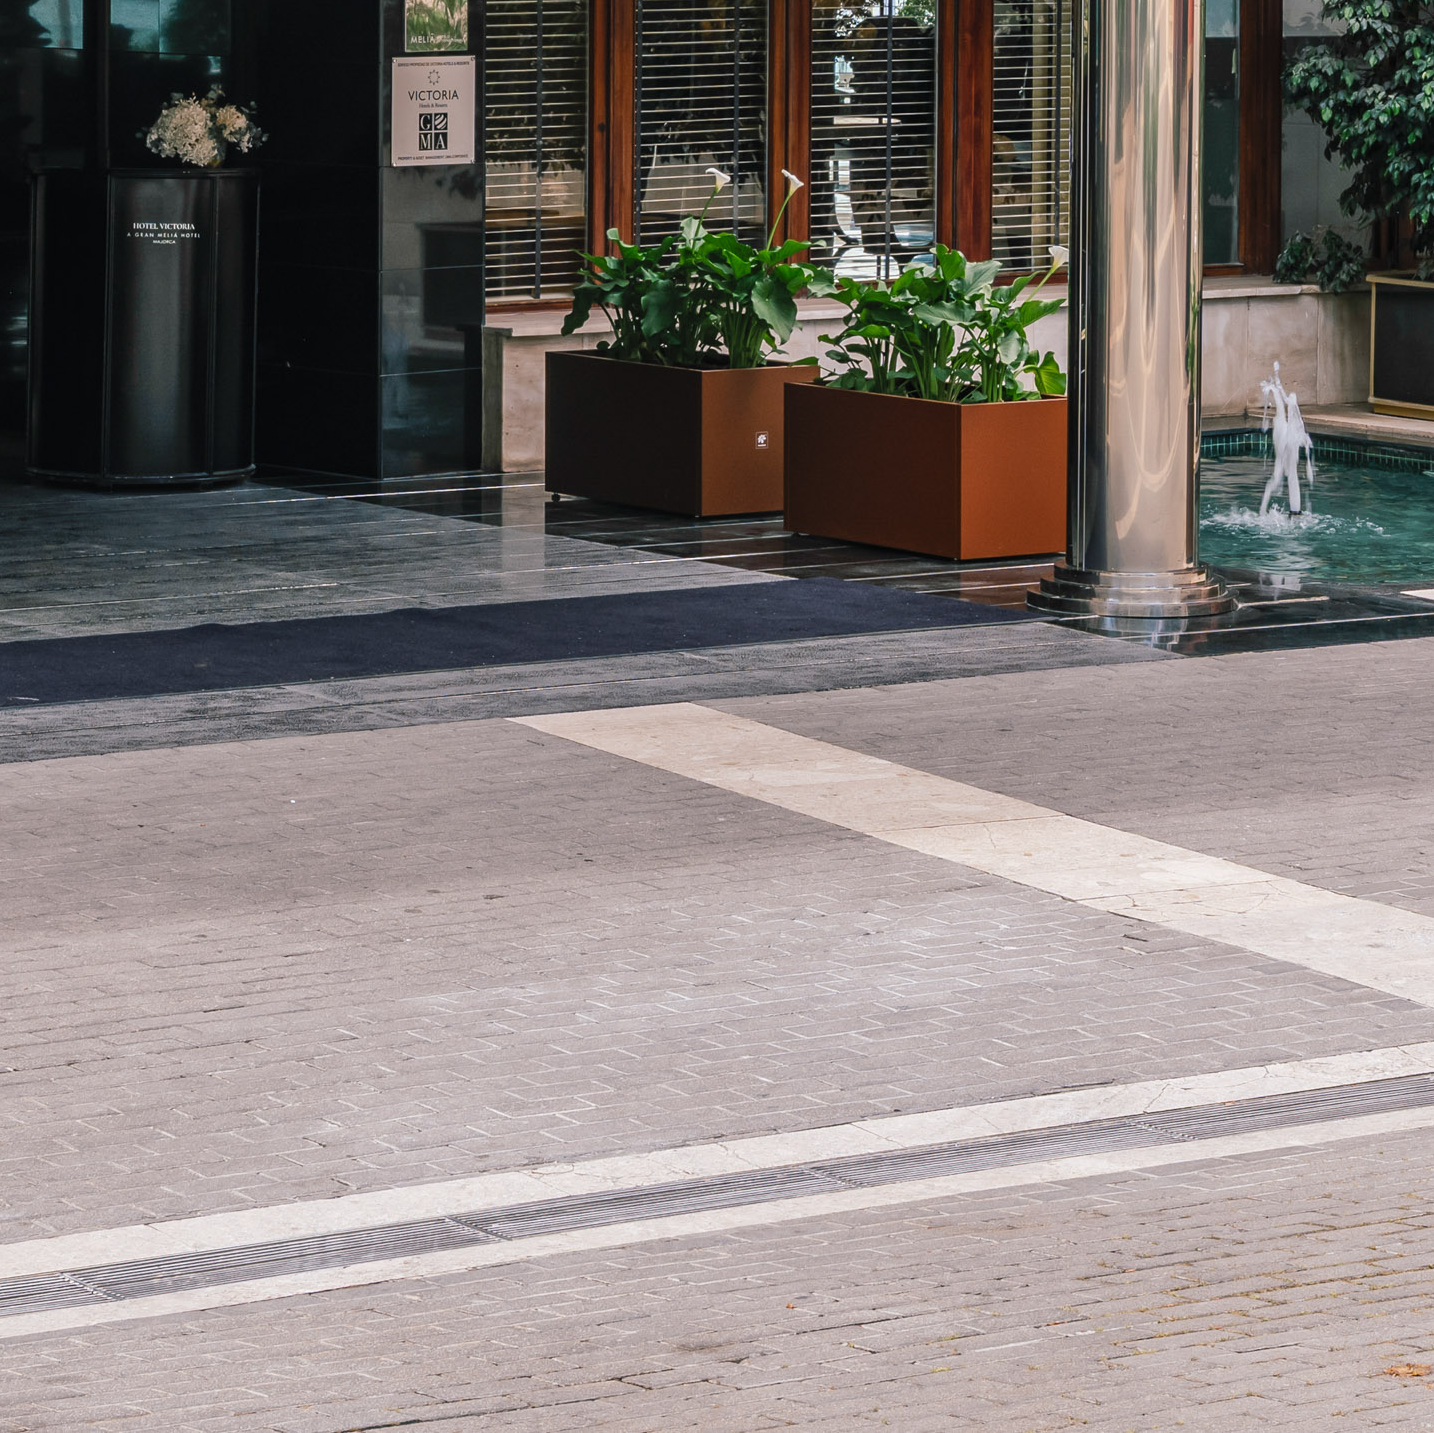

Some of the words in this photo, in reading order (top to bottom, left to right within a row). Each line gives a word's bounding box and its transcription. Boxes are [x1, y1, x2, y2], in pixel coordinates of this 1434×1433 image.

[408, 90, 459, 101] VICTORIA
[133, 222, 158, 230] HOTEL
[159, 222, 195, 230] VICTORIA
